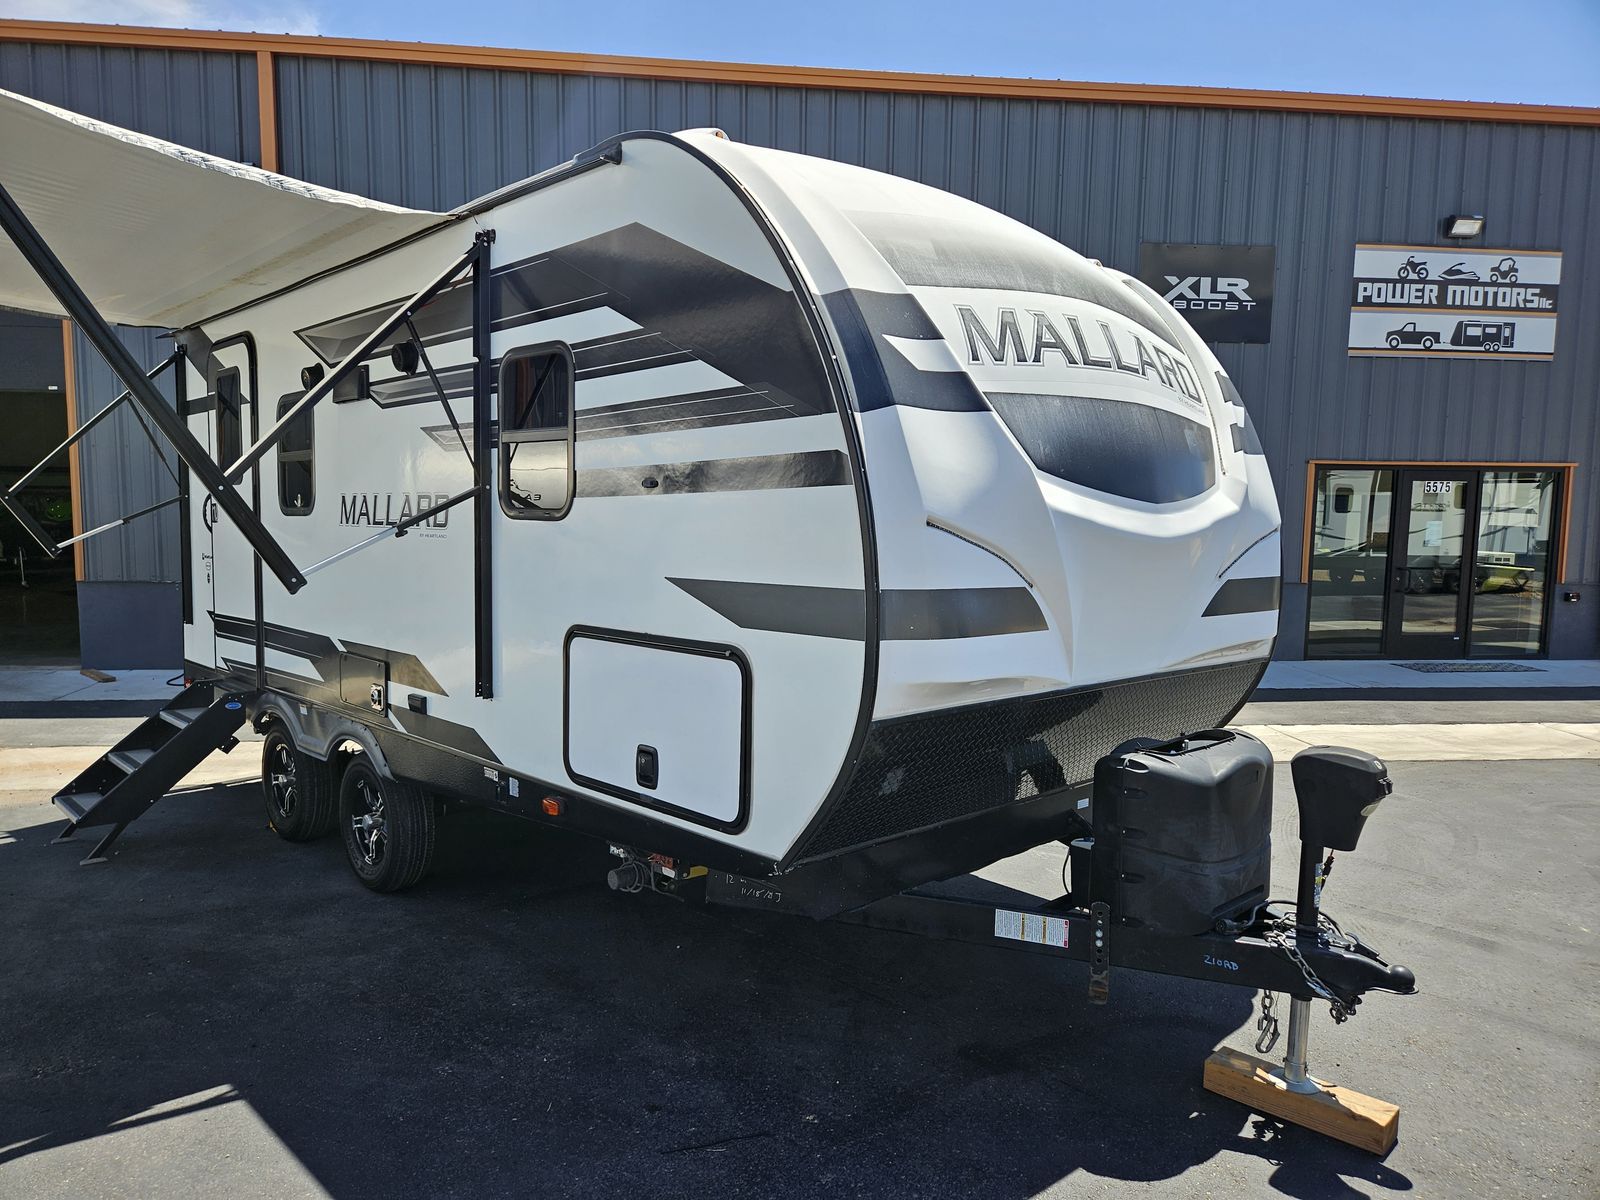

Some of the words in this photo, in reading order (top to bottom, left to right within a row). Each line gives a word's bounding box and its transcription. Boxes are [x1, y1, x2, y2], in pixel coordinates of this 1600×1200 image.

[1163, 275, 1253, 302] XLR
[1357, 282, 1439, 305] POWER
[1446, 285, 1541, 309] MOTORS
[1173, 300, 1257, 311] BOOST
[953, 303, 1204, 407] MALLARD
[1425, 481, 1451, 493] 5575
[339, 492, 450, 531] MALLARD
